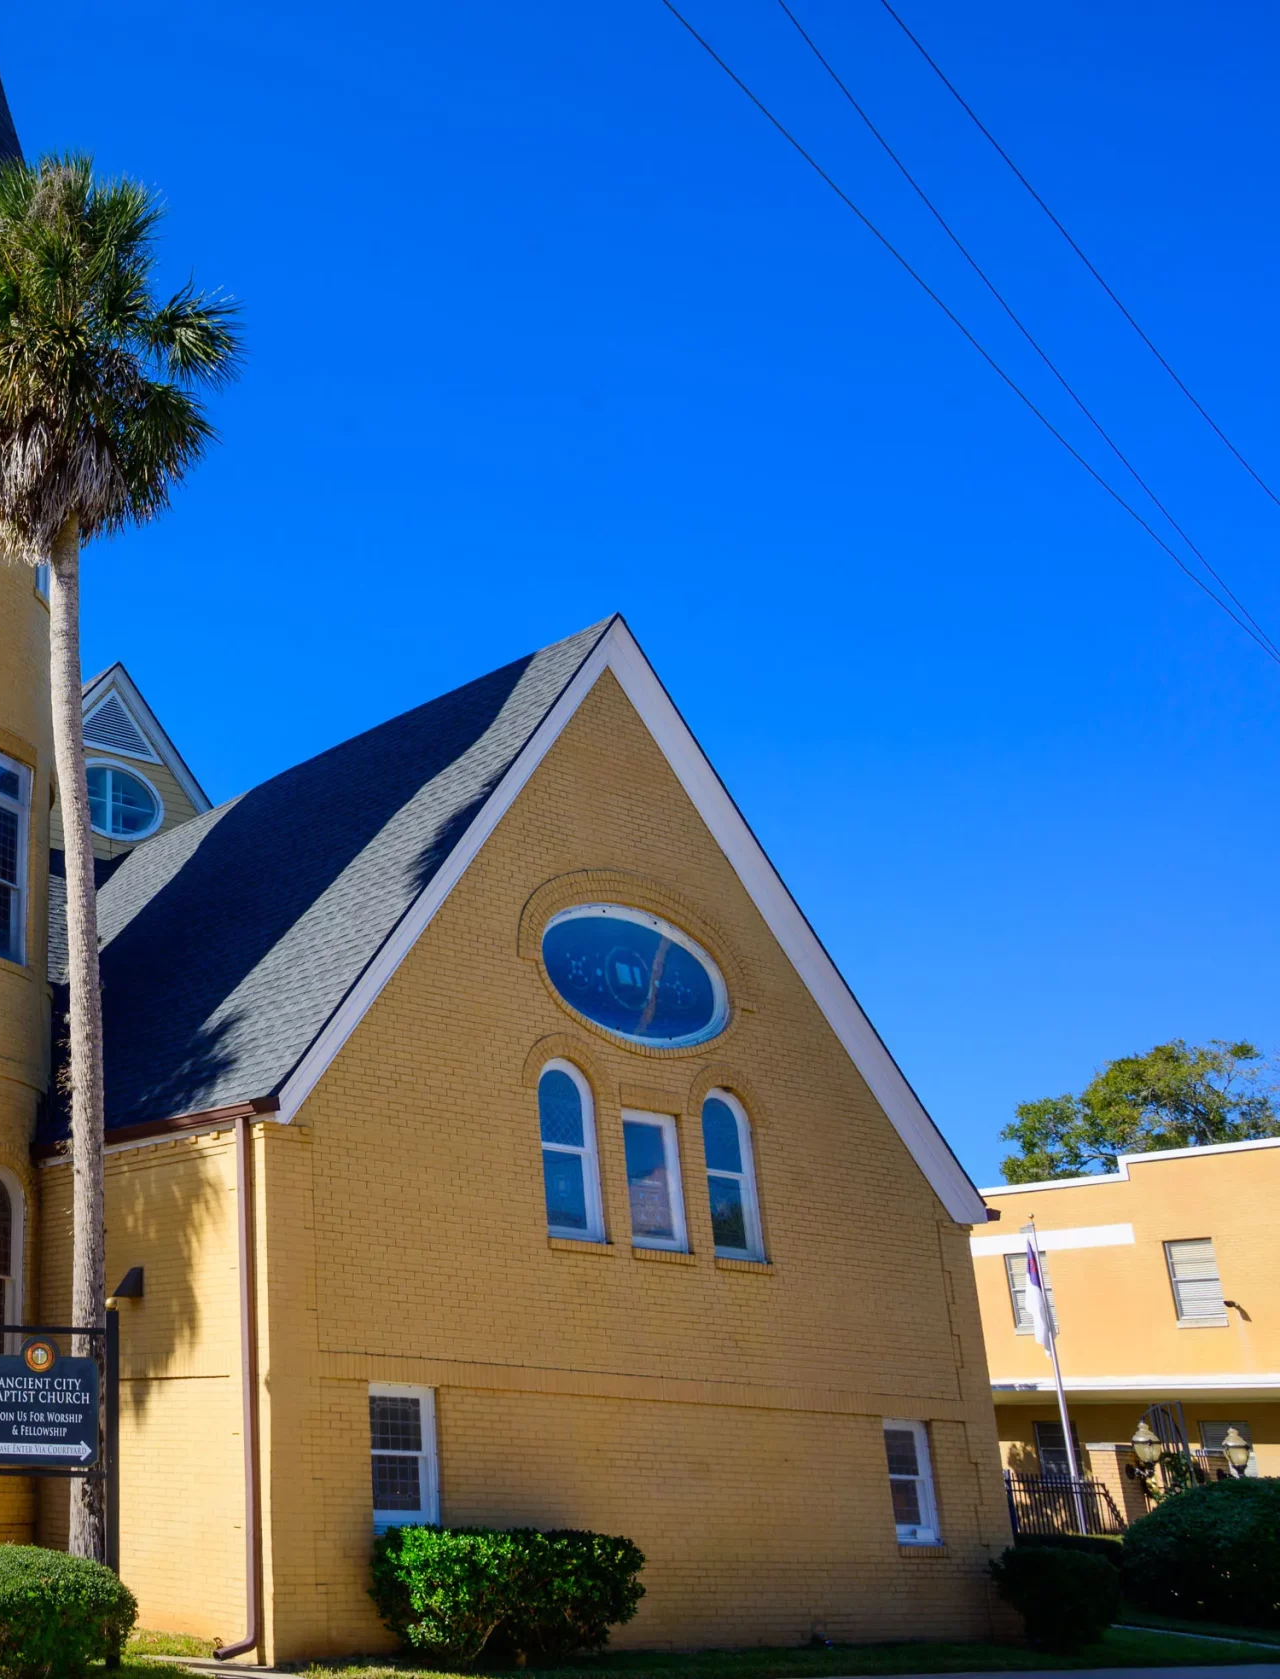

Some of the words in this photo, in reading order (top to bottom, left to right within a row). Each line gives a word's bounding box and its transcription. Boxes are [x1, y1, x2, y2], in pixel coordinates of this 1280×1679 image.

[54, 1378, 82, 1390] CITY
[38, 1391, 90, 1404] CHURCH
[11, 1424, 19, 1436] &
